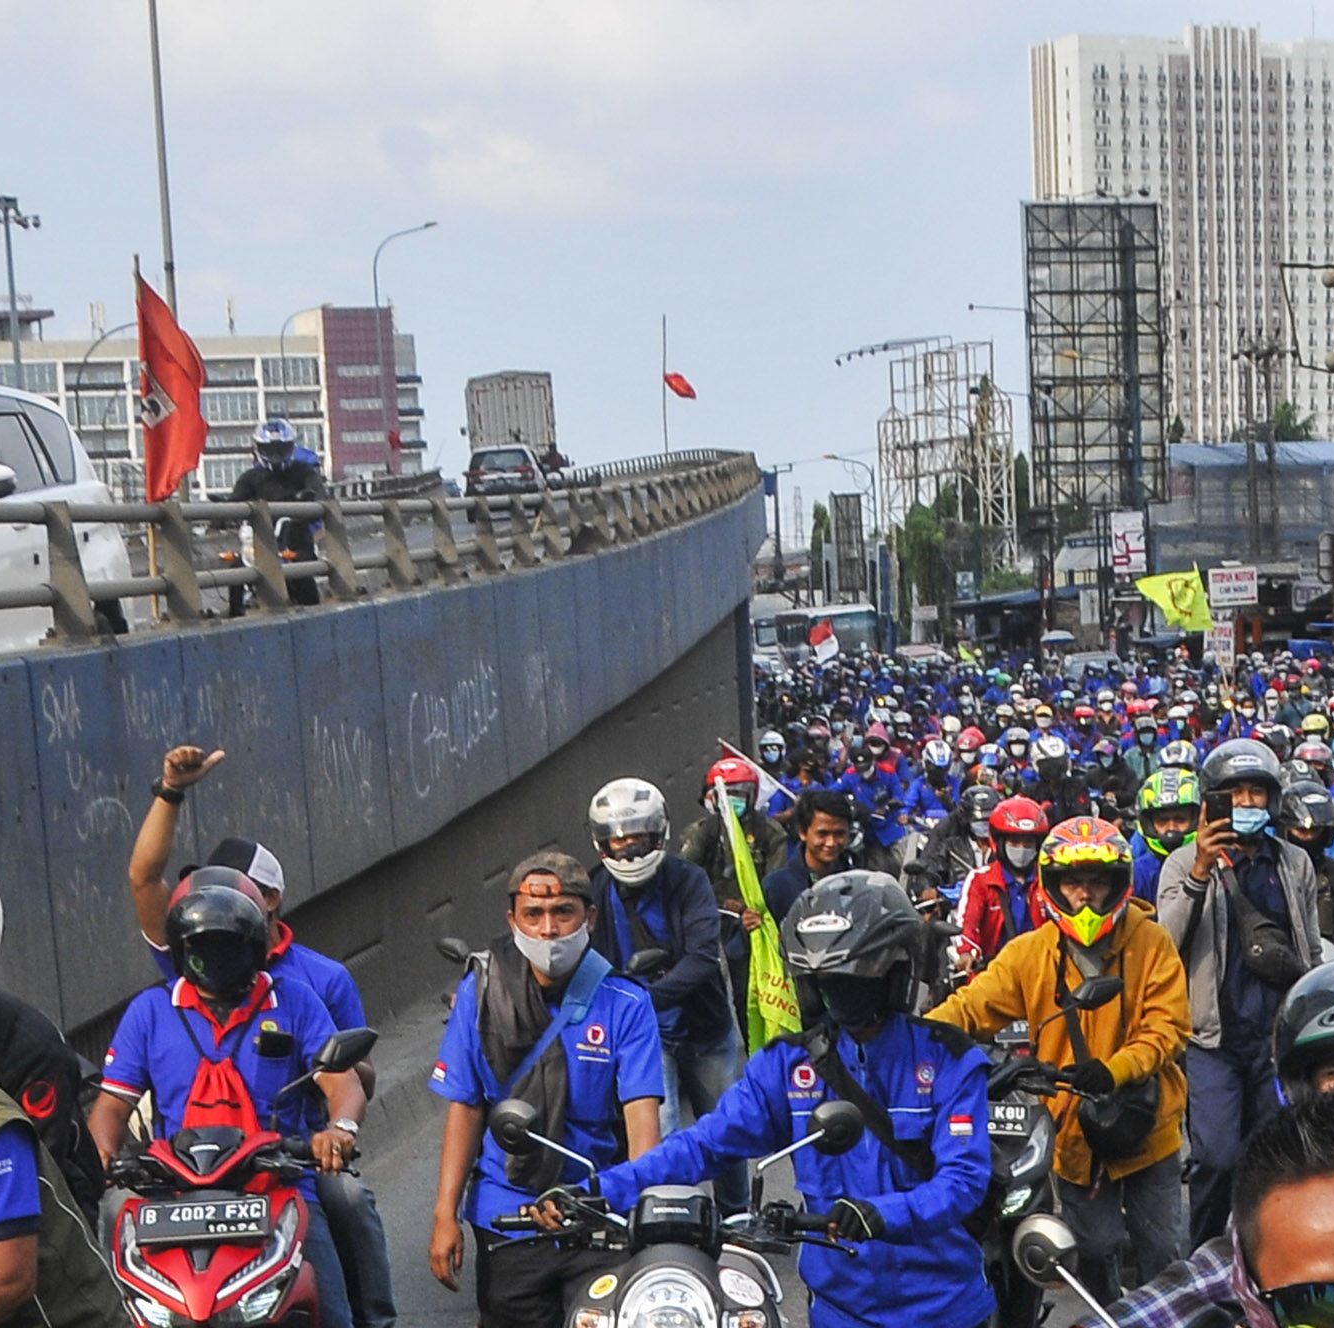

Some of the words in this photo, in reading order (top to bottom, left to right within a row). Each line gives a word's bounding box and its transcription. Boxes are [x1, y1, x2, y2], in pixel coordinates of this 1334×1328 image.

[145, 1209, 157, 1225] B
[170, 1205, 216, 1222] 4002
[225, 1202, 262, 1219] FXC
[652, 1206, 690, 1215] HONDA
